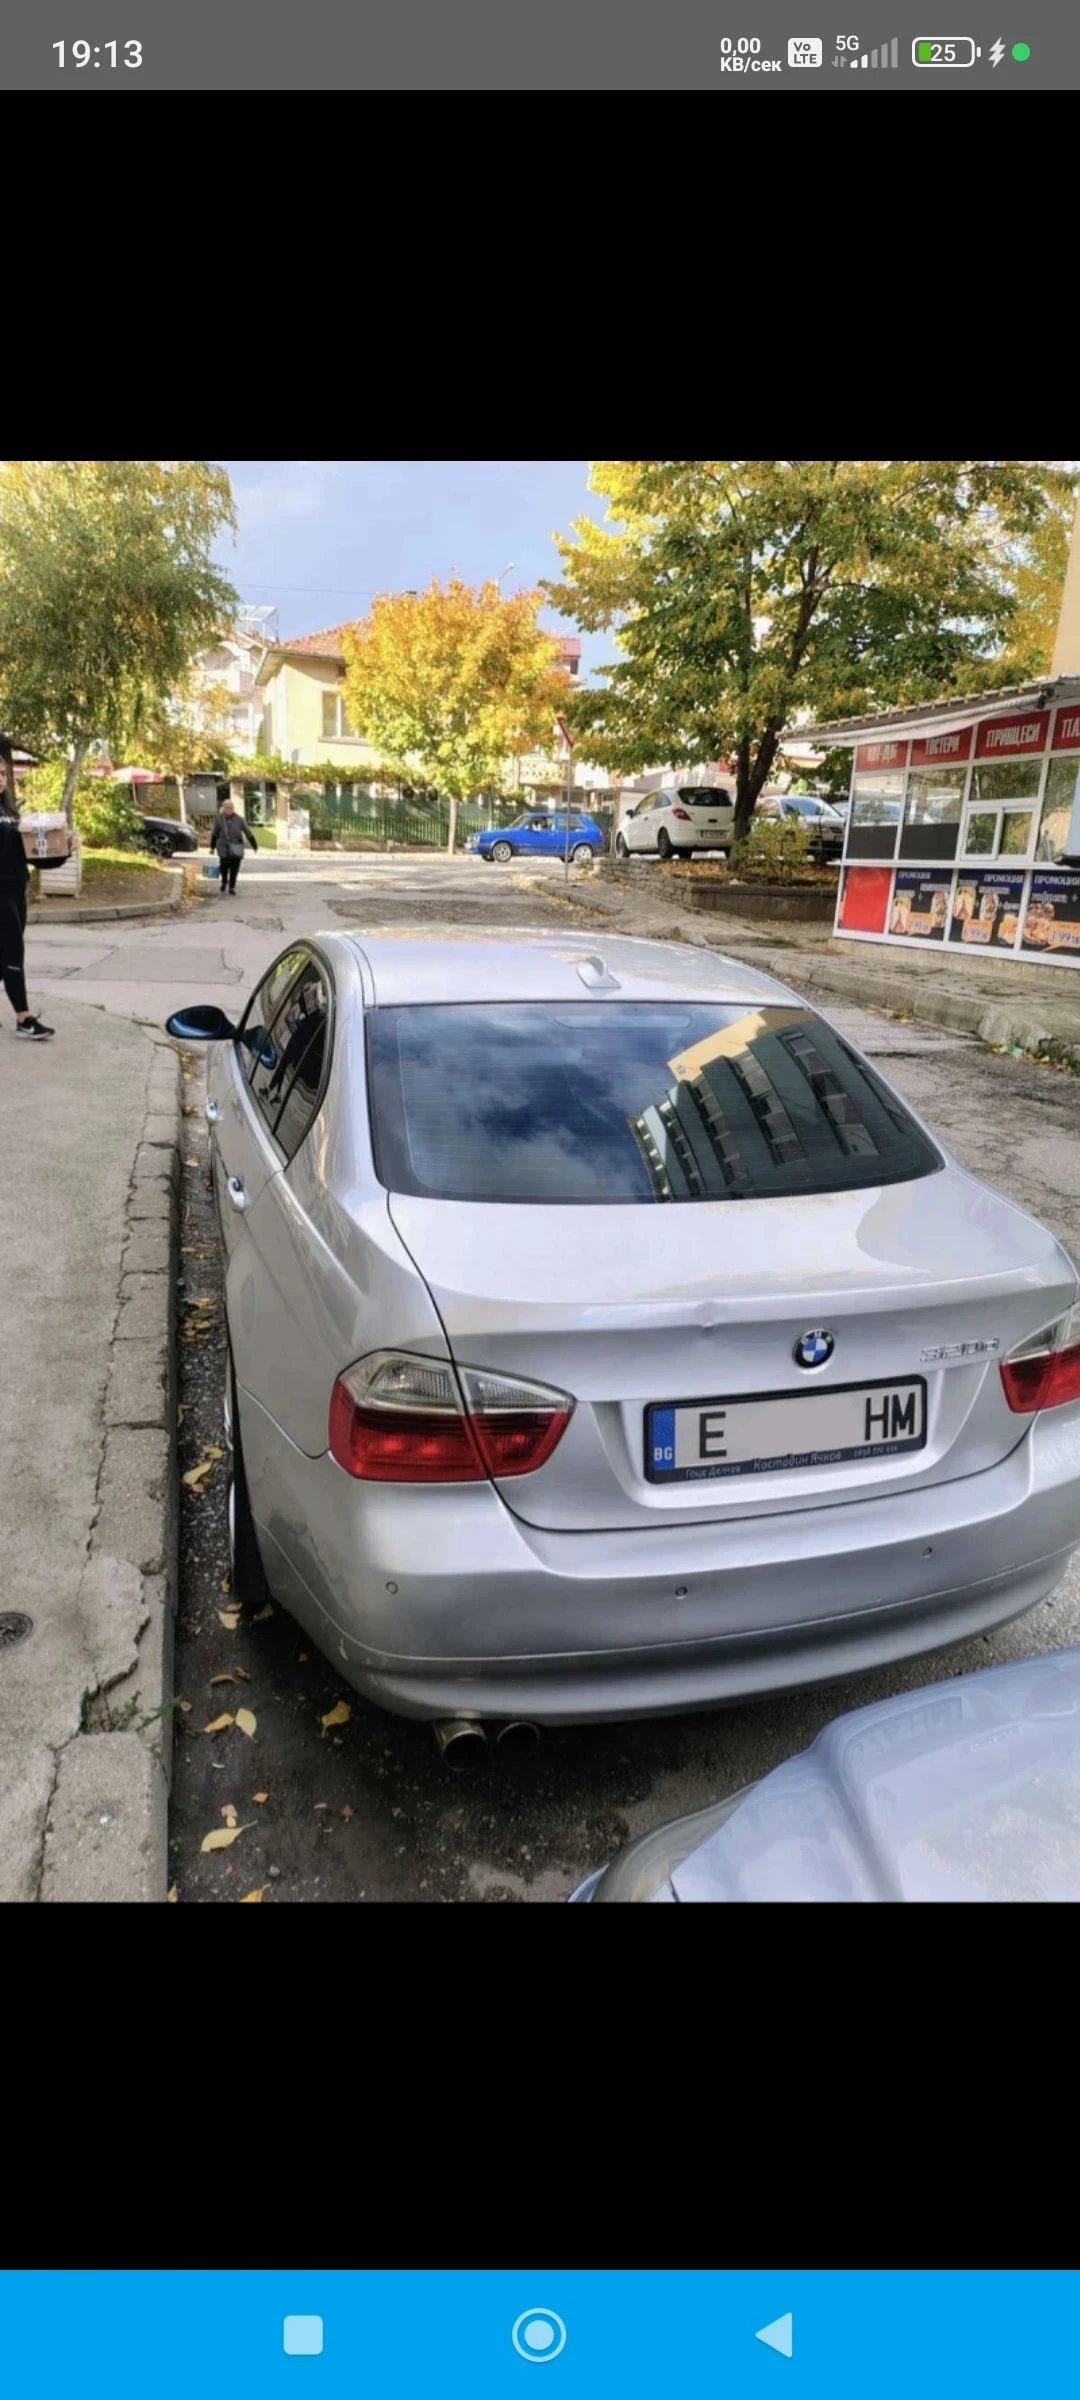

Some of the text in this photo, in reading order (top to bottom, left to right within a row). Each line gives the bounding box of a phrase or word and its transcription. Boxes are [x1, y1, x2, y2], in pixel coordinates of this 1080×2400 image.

[1061, 716, 1080, 738] ПА
[700, 1392, 916, 1459] E HM
[654, 1446, 673, 1461] BG
